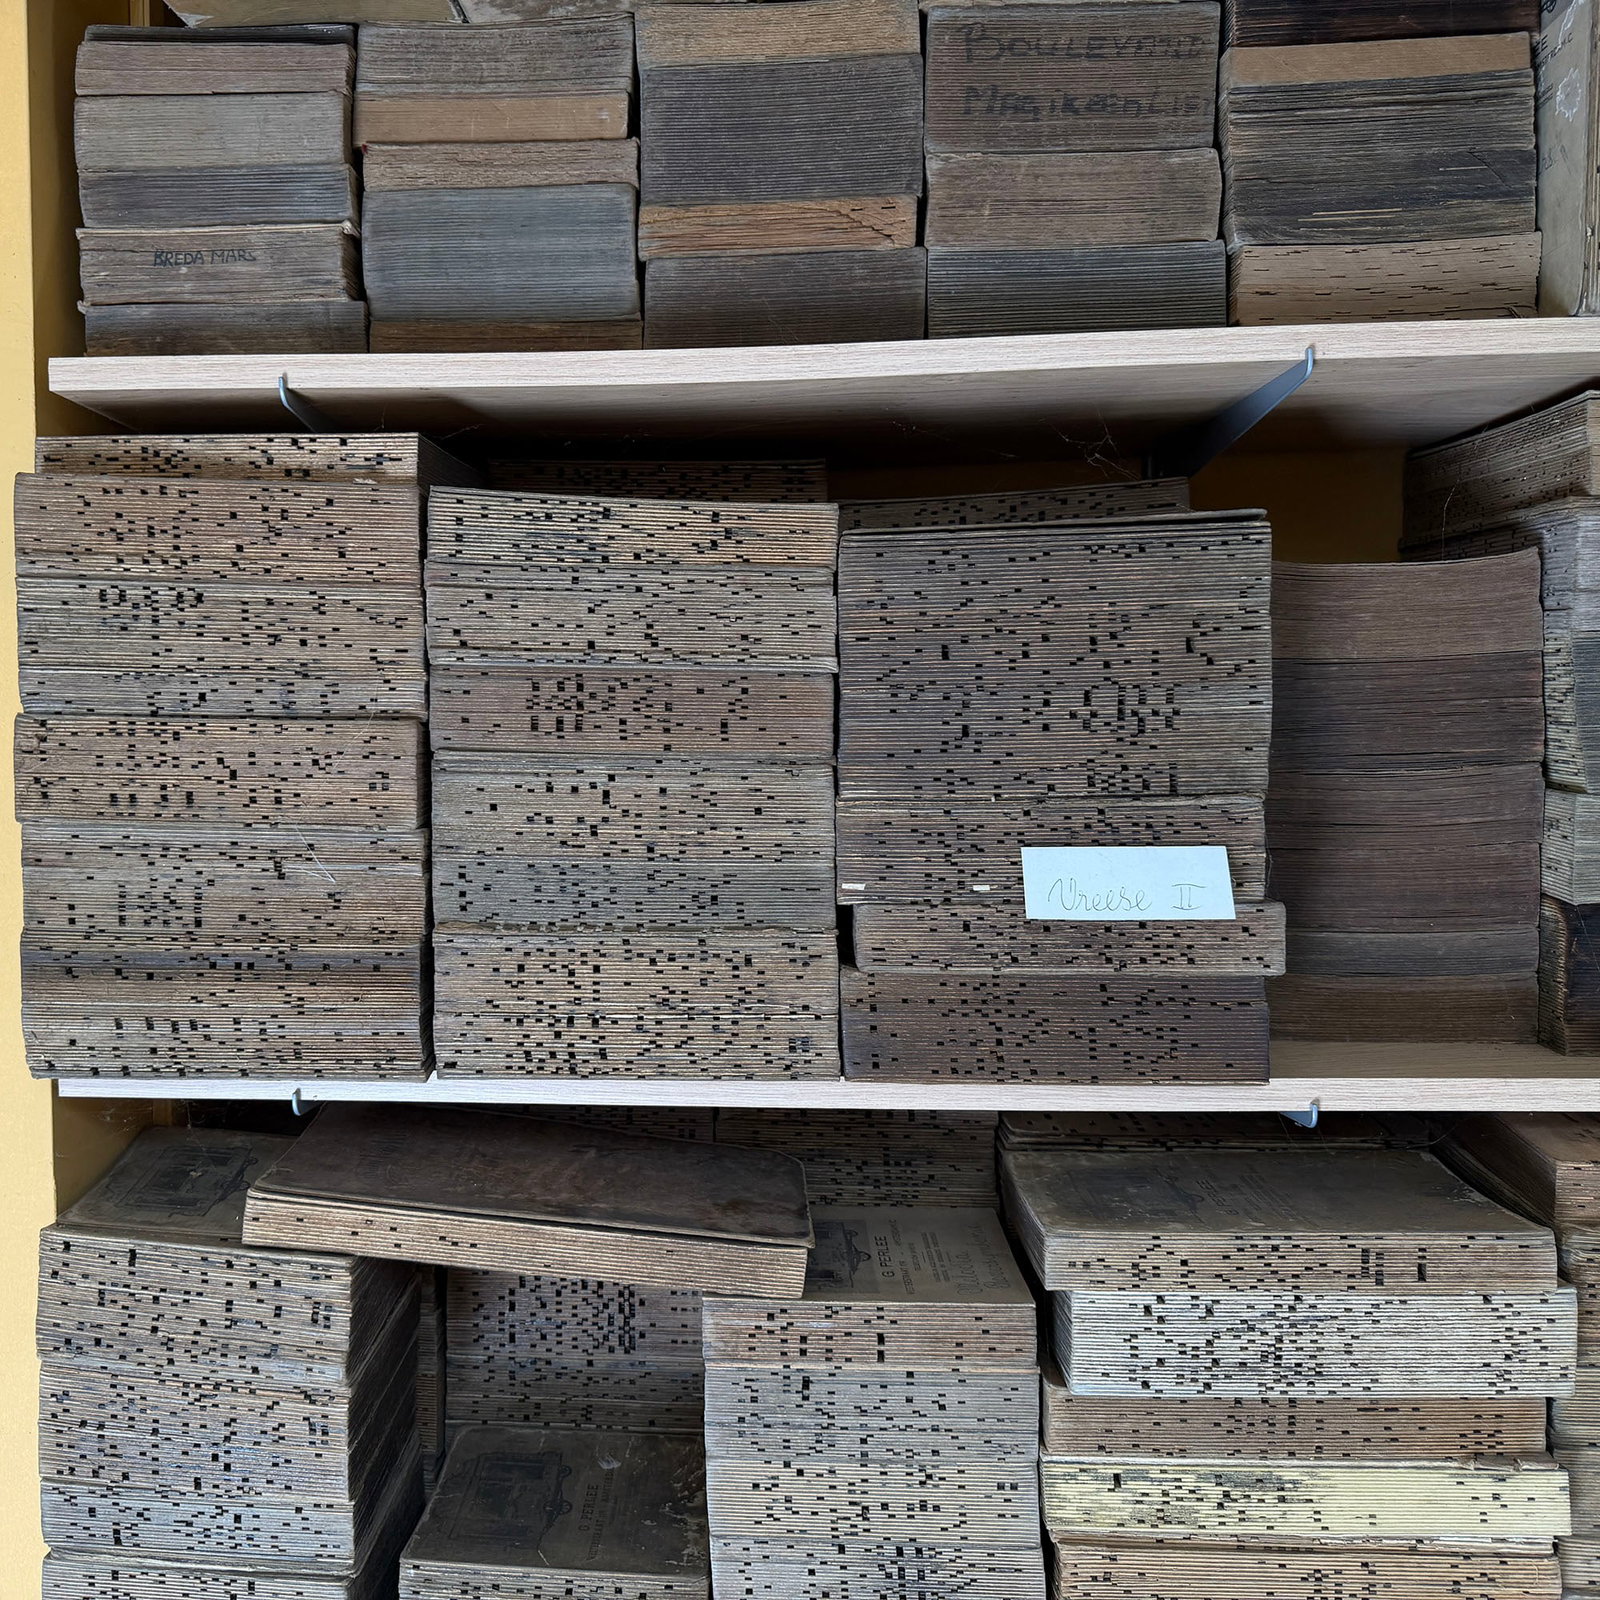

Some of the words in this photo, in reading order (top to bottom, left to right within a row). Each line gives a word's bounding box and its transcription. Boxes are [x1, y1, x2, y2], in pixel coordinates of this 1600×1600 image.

[153, 249, 205, 267] BREDA
[210, 249, 257, 265] MARS
[874, 1235, 892, 1268] PERLEE
[881, 1270, 896, 1278] G
[580, 1484, 599, 1521] PERLEE
